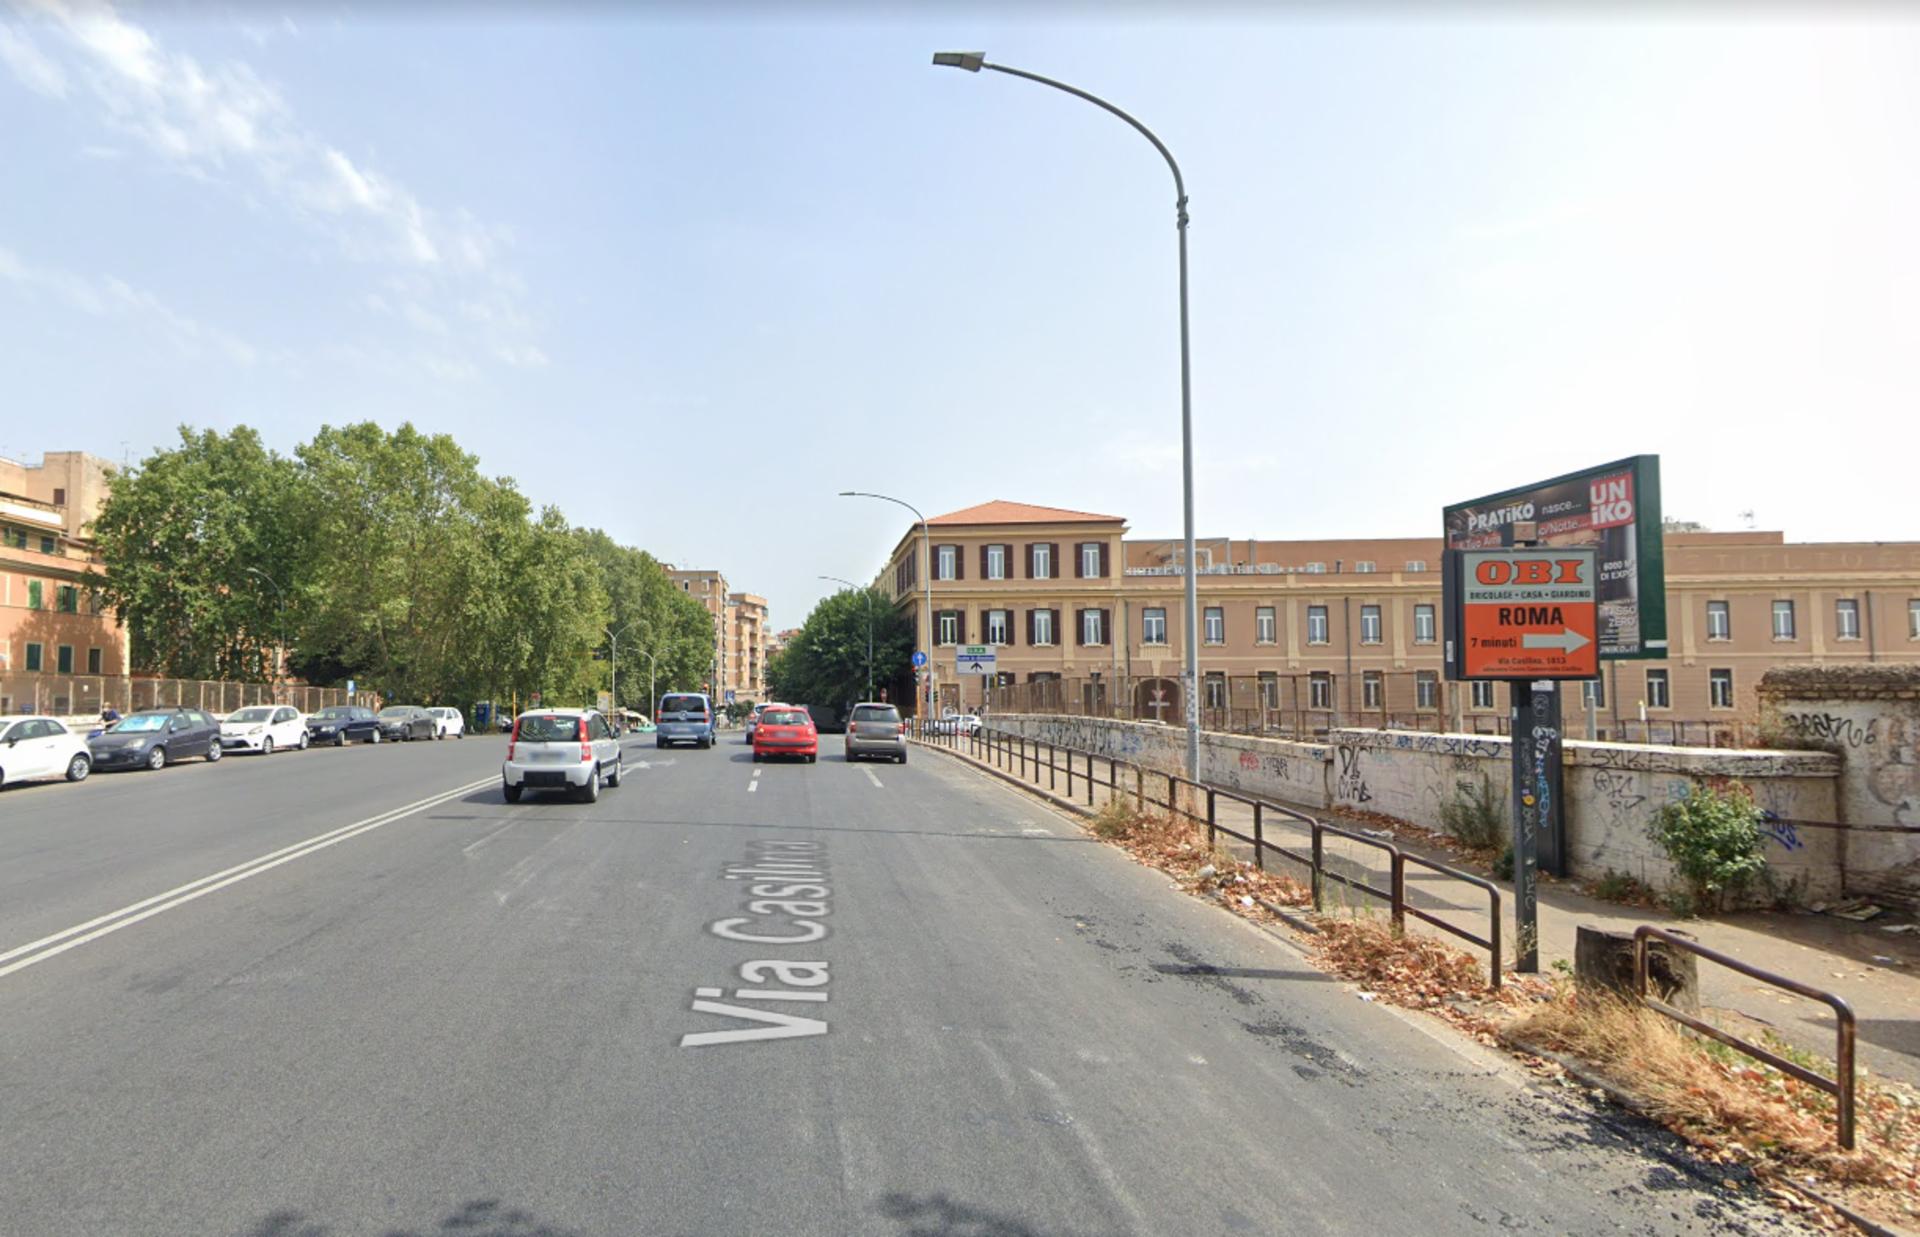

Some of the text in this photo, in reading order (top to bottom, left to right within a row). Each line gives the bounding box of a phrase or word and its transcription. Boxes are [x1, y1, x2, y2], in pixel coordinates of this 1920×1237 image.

[1590, 479, 1626, 504] UN
[1591, 500, 1632, 525] iKO
[1475, 559, 1584, 585] OBI
[1470, 590, 1591, 599] BRICOLAGE CASA GIARDINO
[1499, 606, 1564, 626] ROMA
[1471, 636, 1517, 648] 7 minuti
